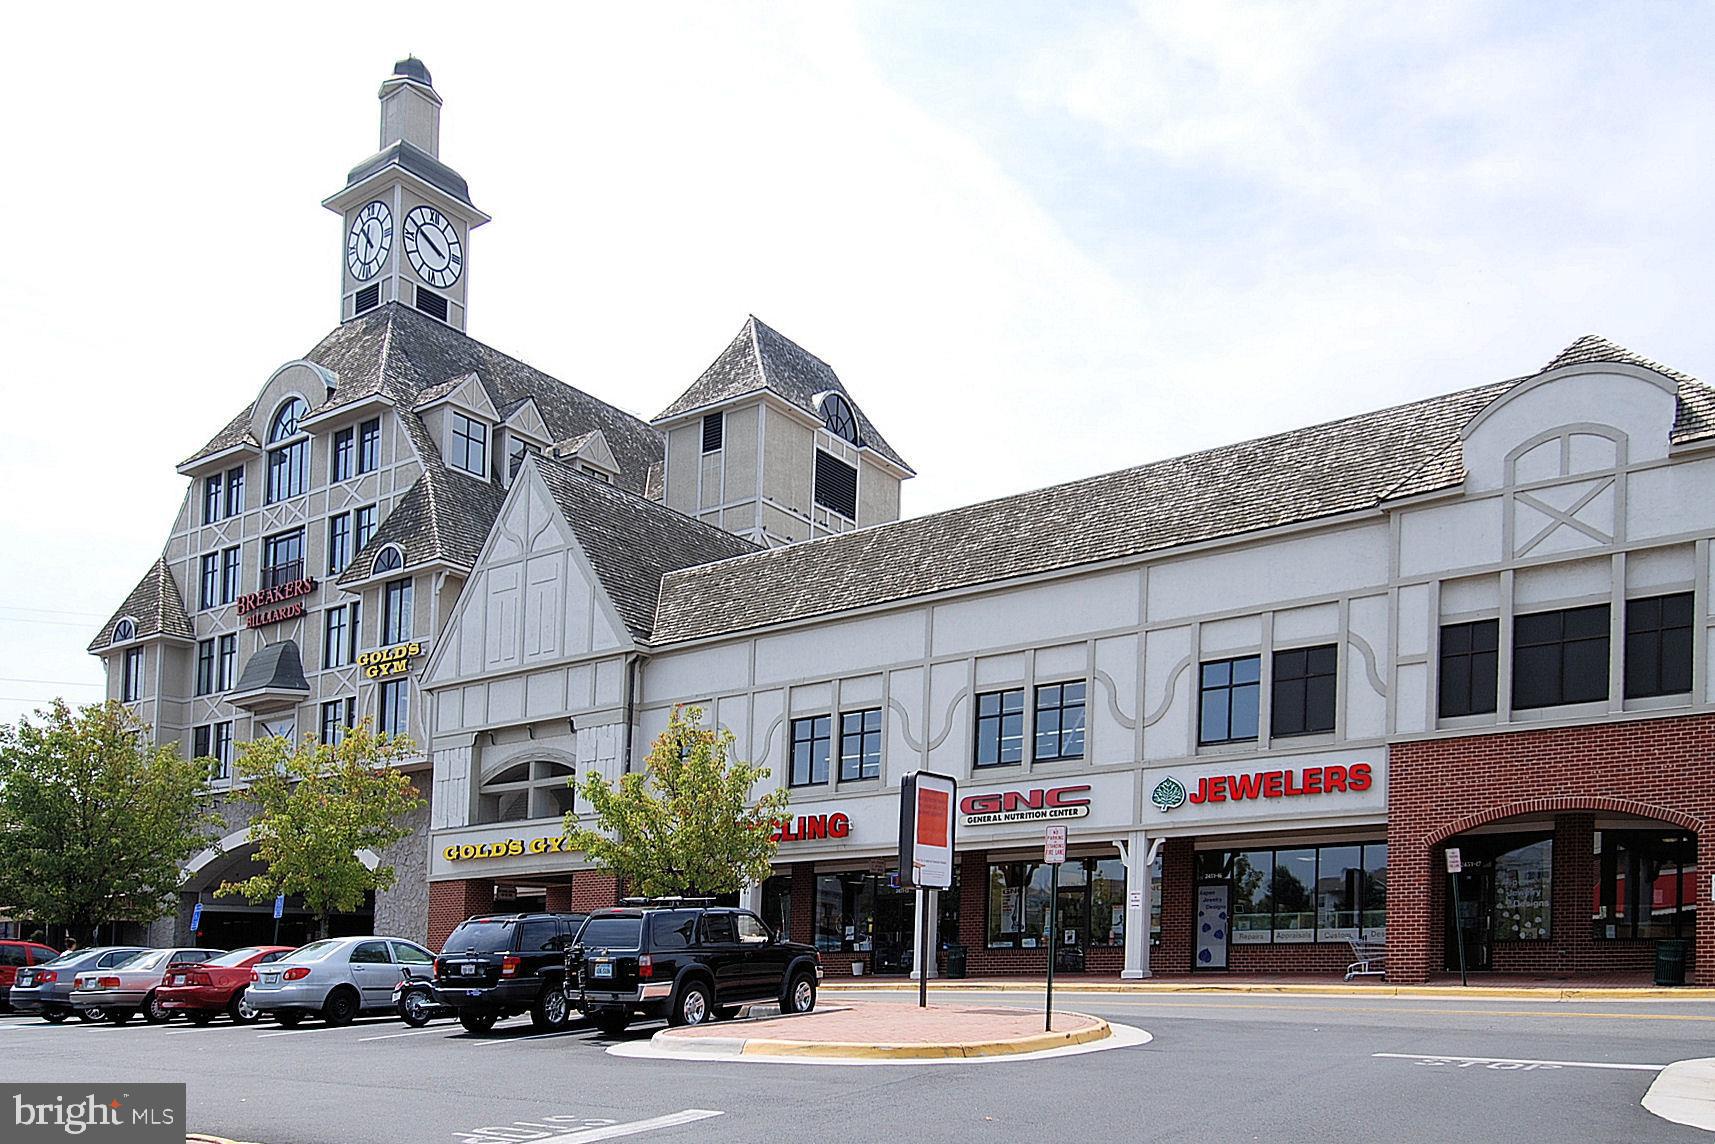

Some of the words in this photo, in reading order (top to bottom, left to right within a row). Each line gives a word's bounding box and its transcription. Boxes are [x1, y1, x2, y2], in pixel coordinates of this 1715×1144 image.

[237, 577, 313, 615] BREAKERS
[246, 602, 303, 629] BILLIARDS
[356, 643, 421, 666] GOLD'S
[366, 659, 408, 679] GYM
[1189, 763, 1373, 804] JEWELERS
[960, 785, 1091, 815] GNC
[967, 814, 1002, 824] GENERAL
[1004, 810, 1047, 821] NUTRITION
[1049, 807, 1079, 818] CENTER
[443, 839, 524, 861] GOLD'S
[529, 836, 583, 853] GY
